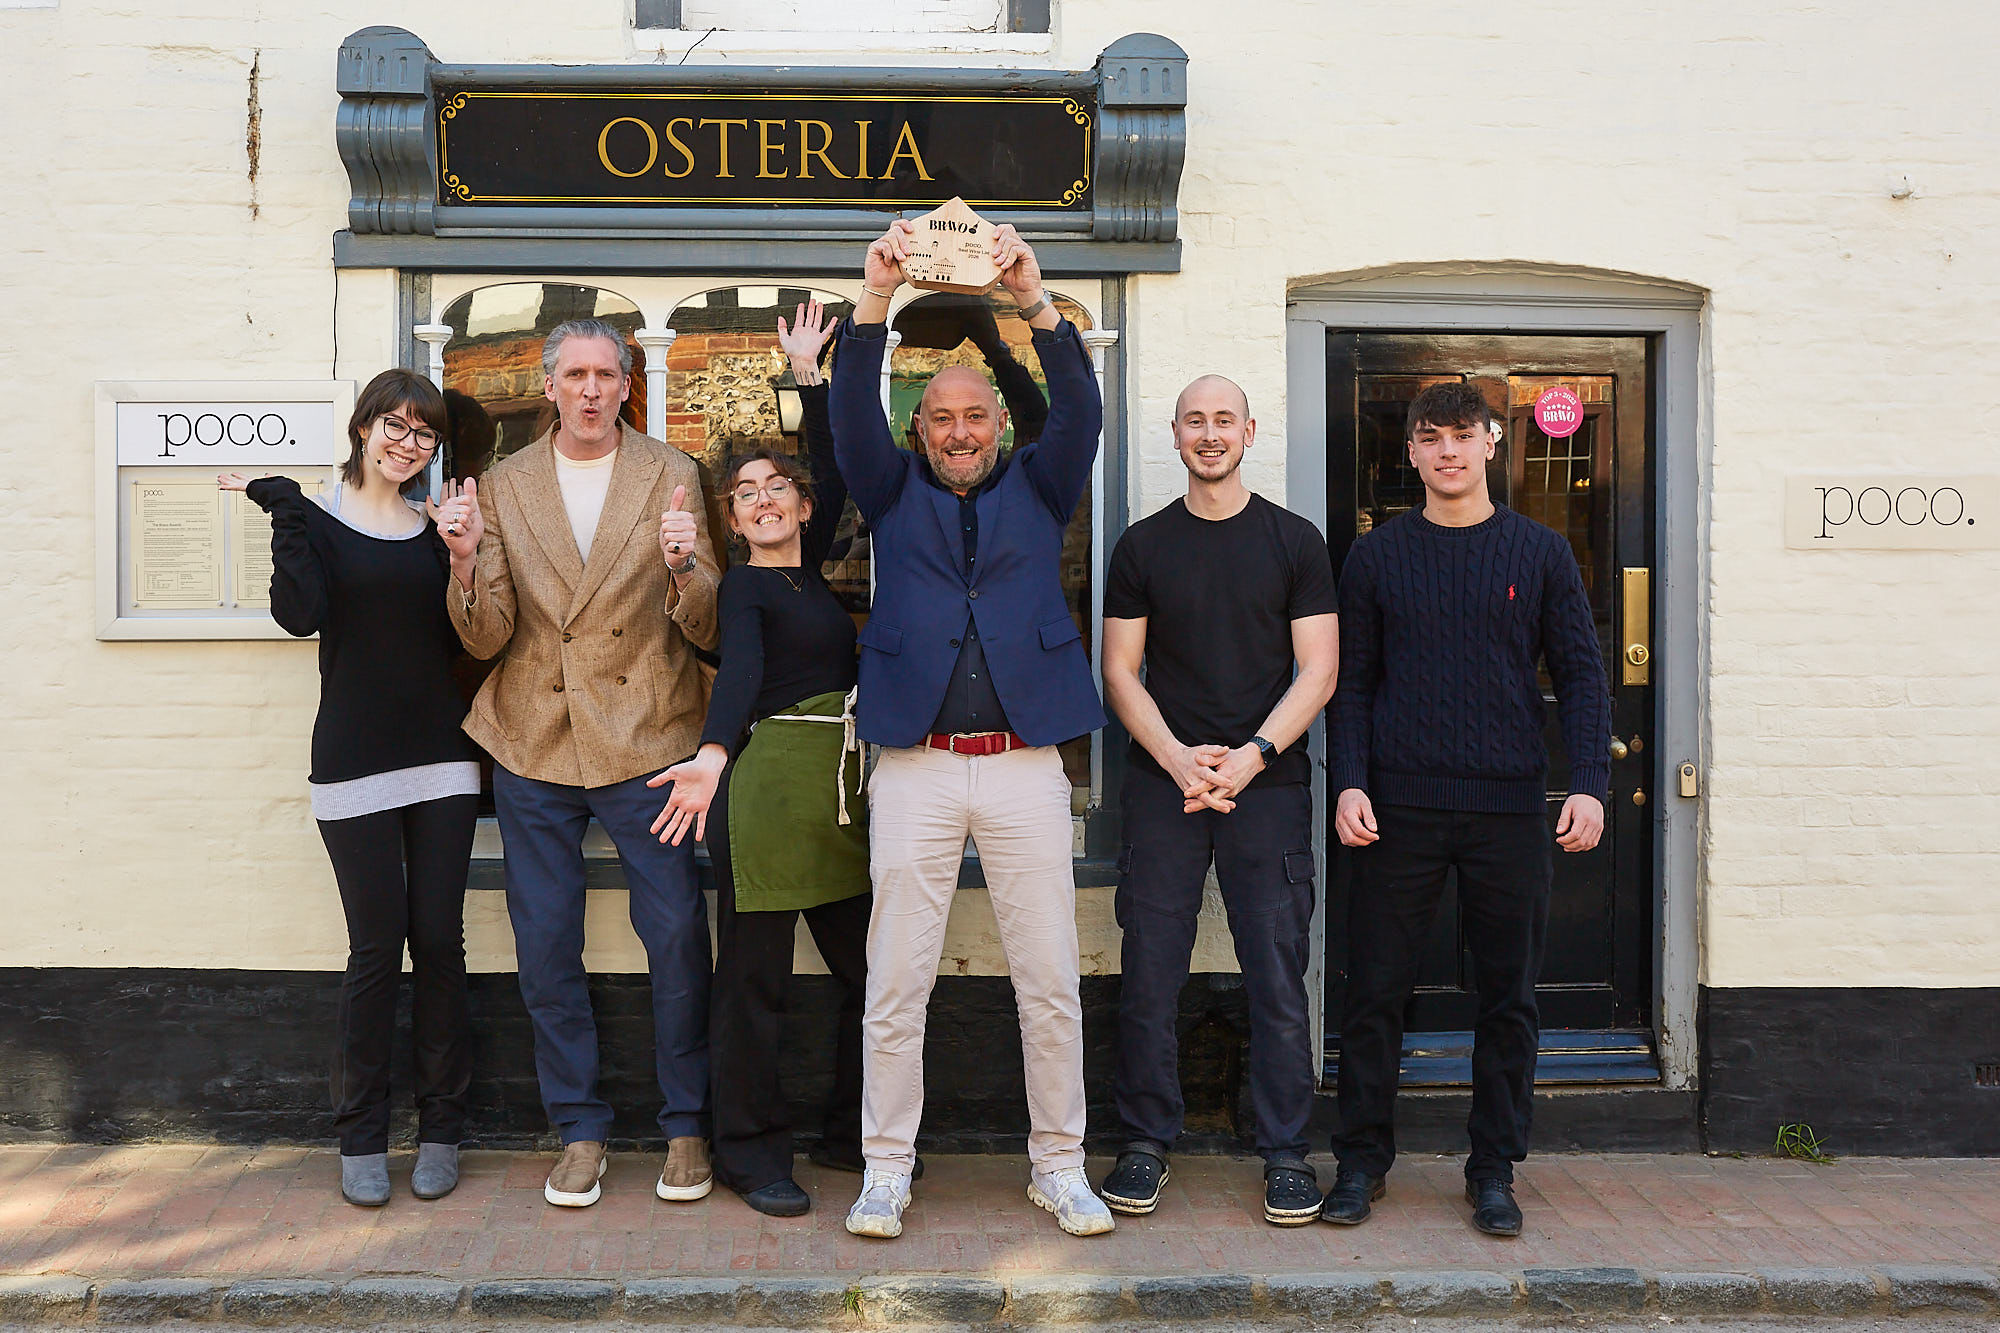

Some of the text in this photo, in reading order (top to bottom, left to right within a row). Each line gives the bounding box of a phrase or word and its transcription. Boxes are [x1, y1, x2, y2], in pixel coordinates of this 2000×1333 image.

[598, 117, 935, 183] OSTERIA
[1541, 392, 1553, 405] TOP
[1543, 409, 1576, 422] BRAVO
[157, 413, 296, 457] poco.
[143, 489, 165, 498] poco.
[1814, 486, 1975, 539] poco.
